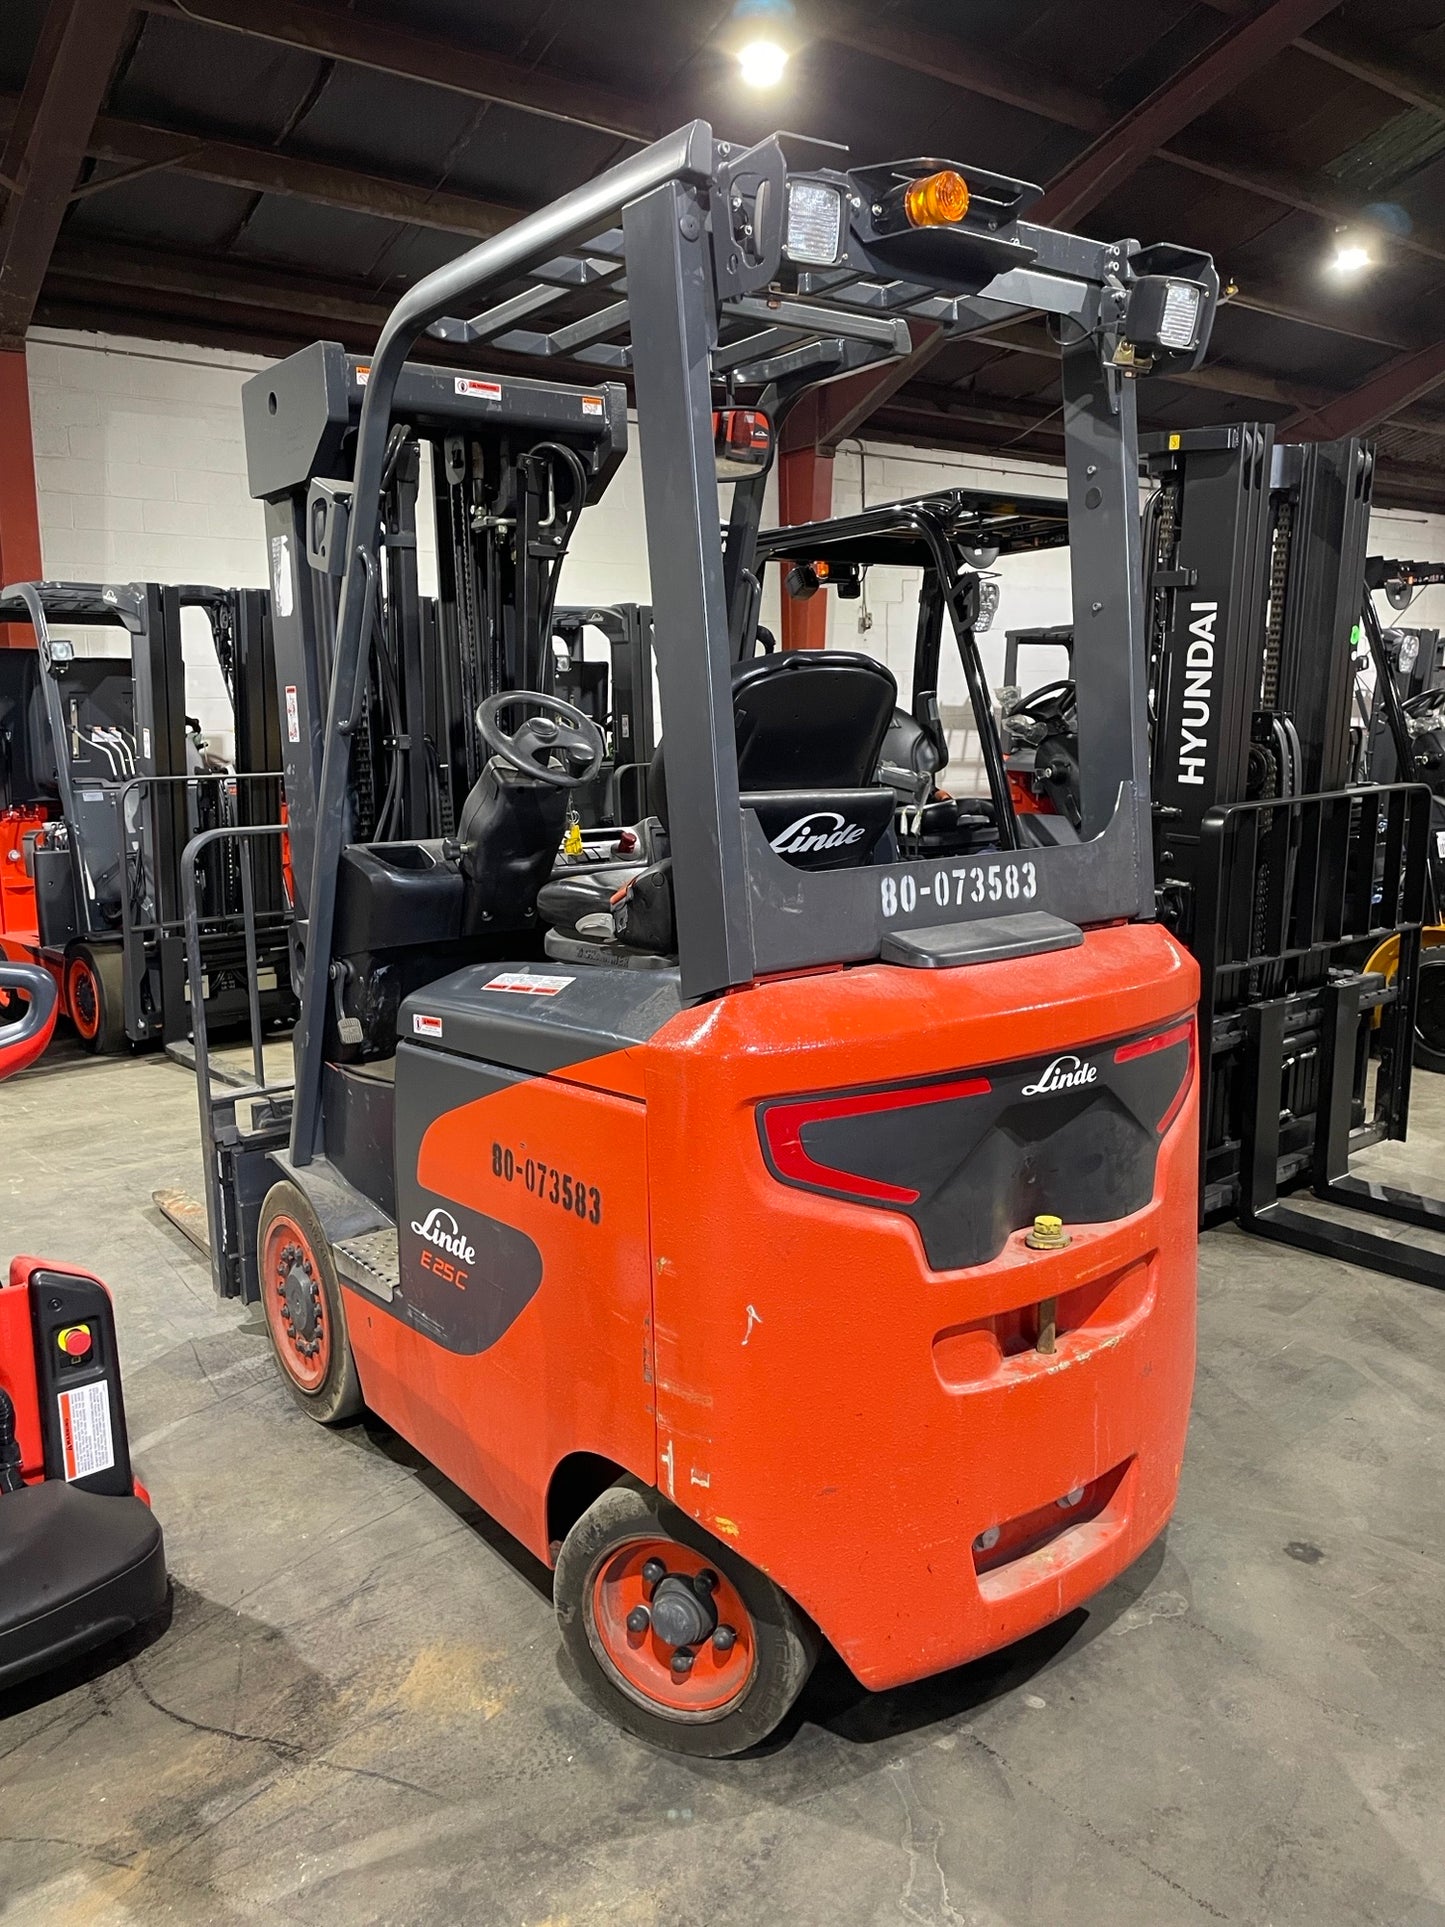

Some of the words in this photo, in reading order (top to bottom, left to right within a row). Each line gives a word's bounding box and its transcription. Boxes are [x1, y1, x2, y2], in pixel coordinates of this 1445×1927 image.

[1178, 602, 1218, 785] HYUNDAI
[769, 812, 866, 853] Linde
[880, 861, 1037, 918] 80-073583
[1021, 1055, 1098, 1096] Linde
[492, 1142, 601, 1225] 80-073583
[411, 1208, 476, 1265] Linde
